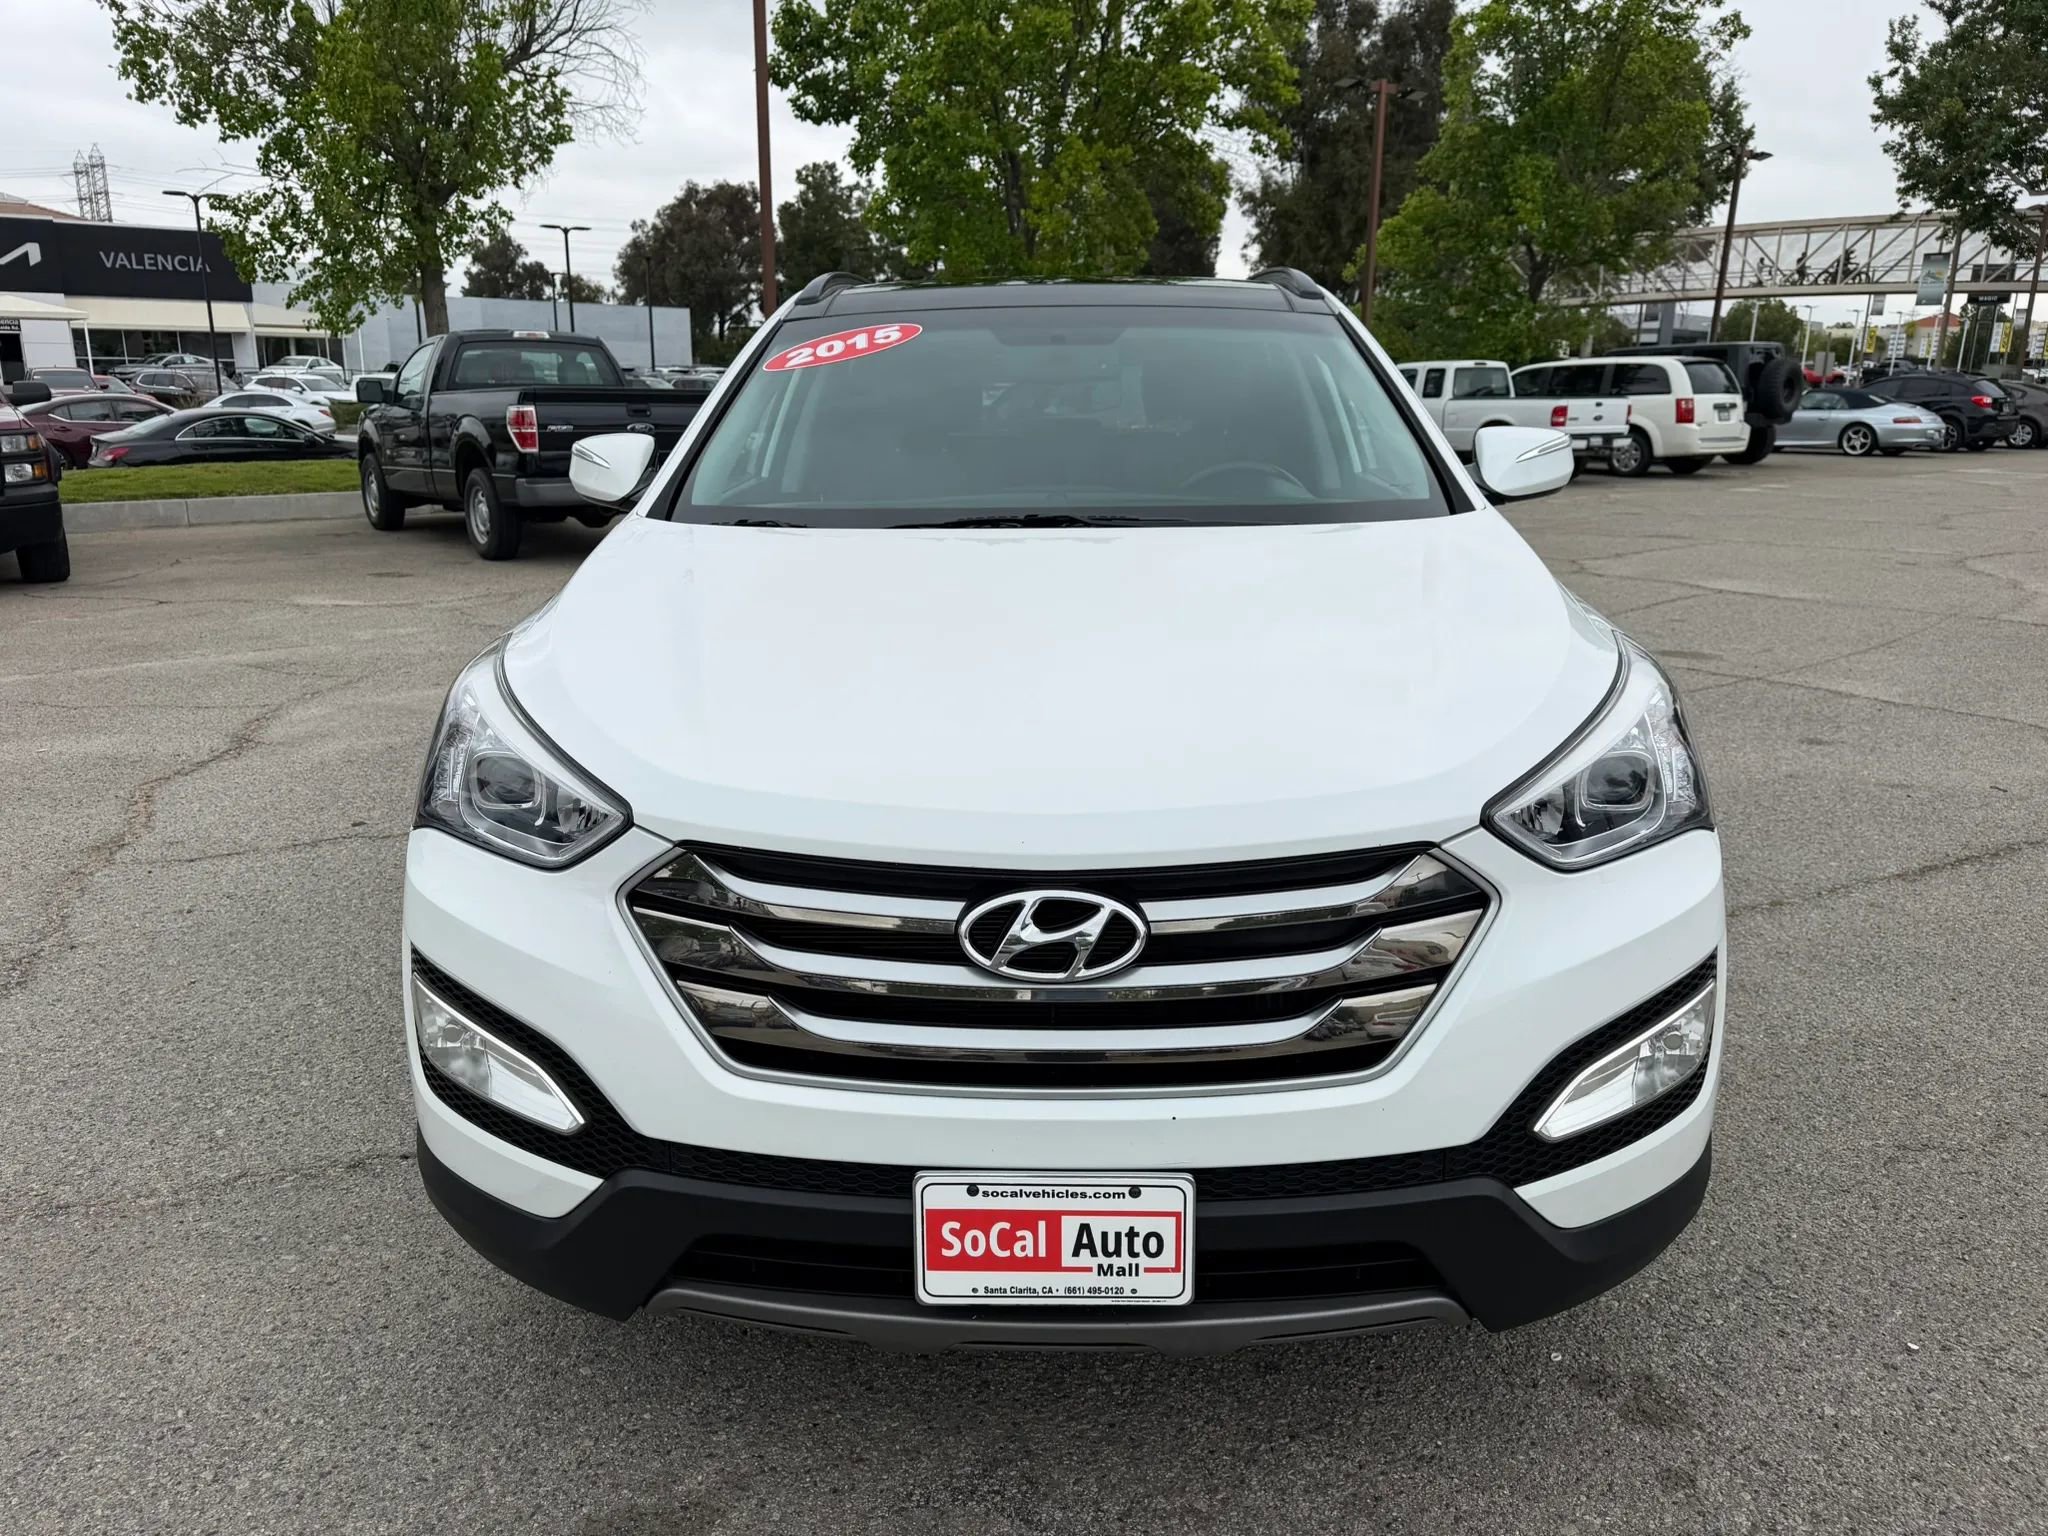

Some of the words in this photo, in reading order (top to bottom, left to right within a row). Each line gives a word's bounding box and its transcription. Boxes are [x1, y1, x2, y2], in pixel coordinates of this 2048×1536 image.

[99, 251, 211, 273] VALENCIA
[784, 325, 903, 368] 2015
[981, 1188, 1126, 1200] socalvehicles.com
[941, 1220, 1047, 1258] SoCal
[1071, 1222, 1165, 1259] Auto
[1097, 1263, 1140, 1278] Mall
[983, 1286, 1007, 1295] Santa
[1010, 1286, 1039, 1296] Clarita,
[1042, 1286, 1054, 1295] CA
[1064, 1286, 1085, 1296] (661)
[1087, 1286, 1125, 1296] 495-0120
